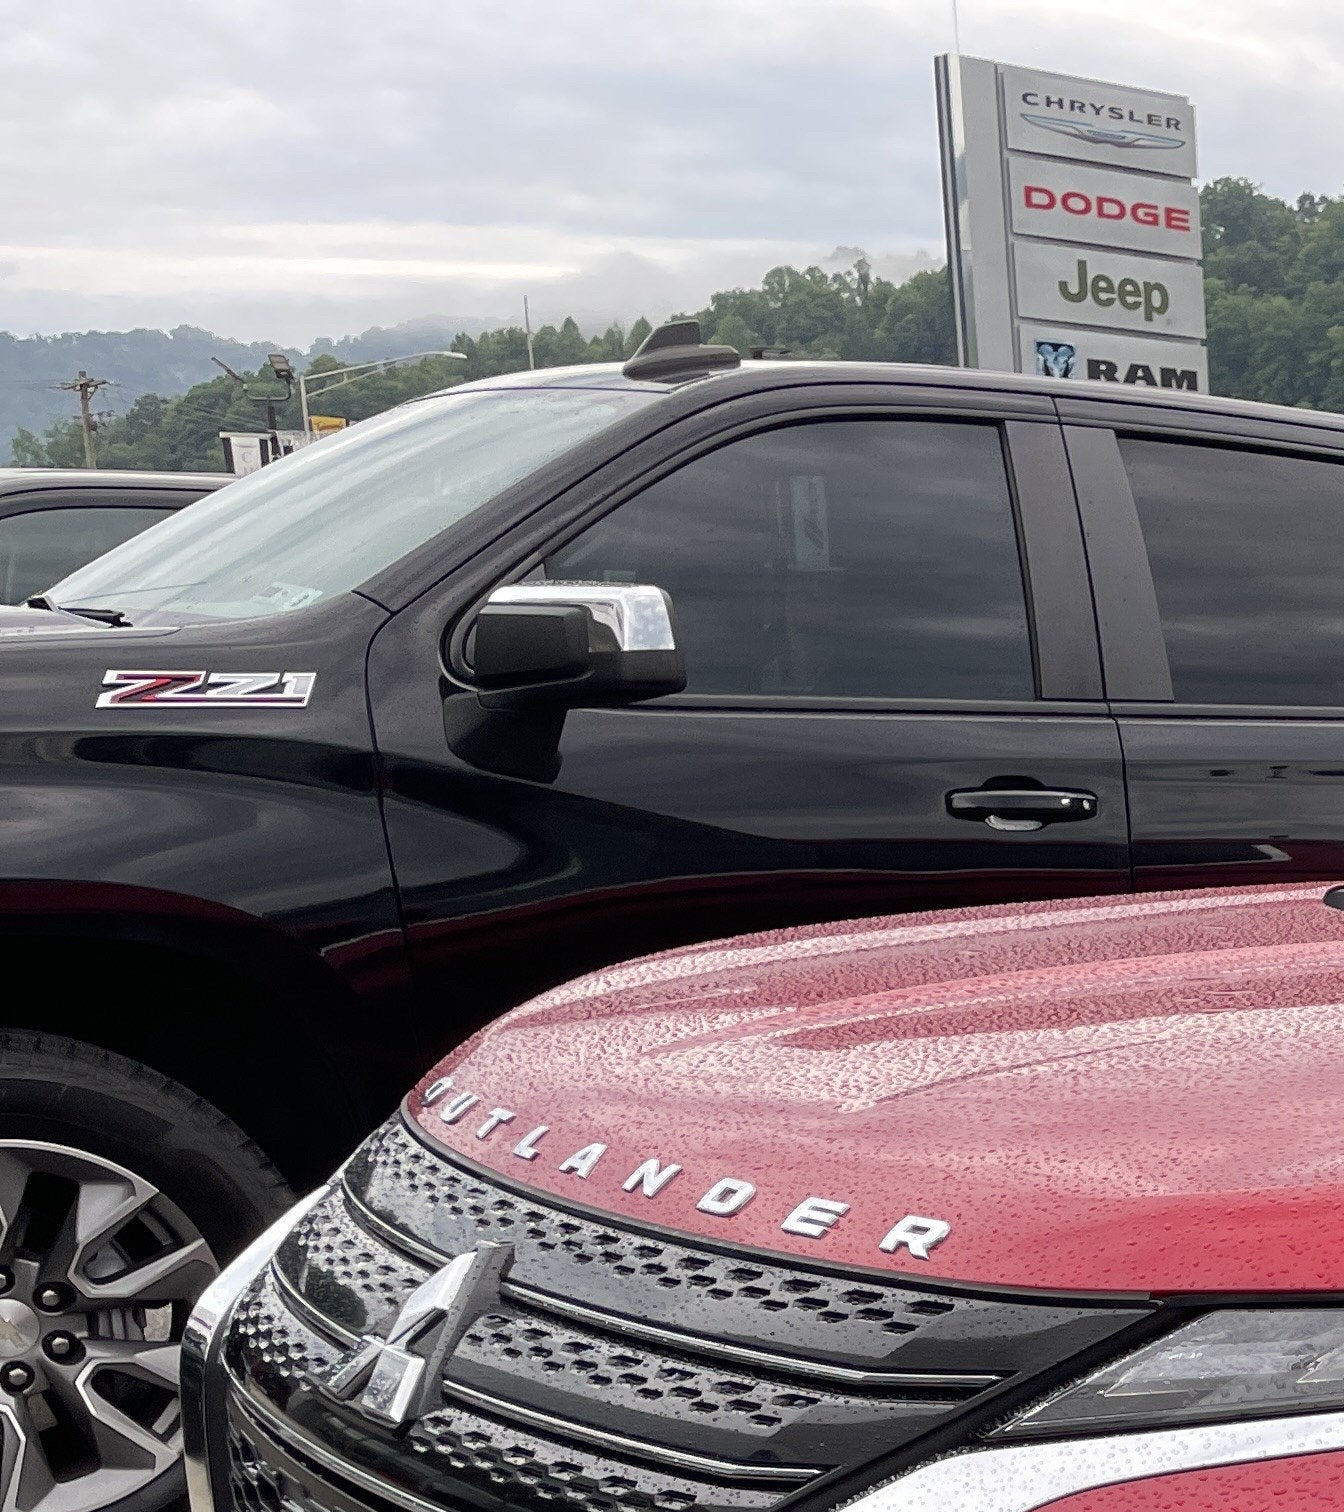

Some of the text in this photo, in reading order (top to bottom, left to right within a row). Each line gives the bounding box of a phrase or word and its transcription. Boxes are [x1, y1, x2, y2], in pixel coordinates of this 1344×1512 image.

[1021, 92, 1182, 132] CHRYSLER
[1023, 185, 1191, 232] DODGE
[1058, 259, 1169, 322] Jeep
[1087, 359, 1198, 391] RAM
[95, 670, 317, 708] Z71
[421, 1076, 952, 1262] OUTLANDER
